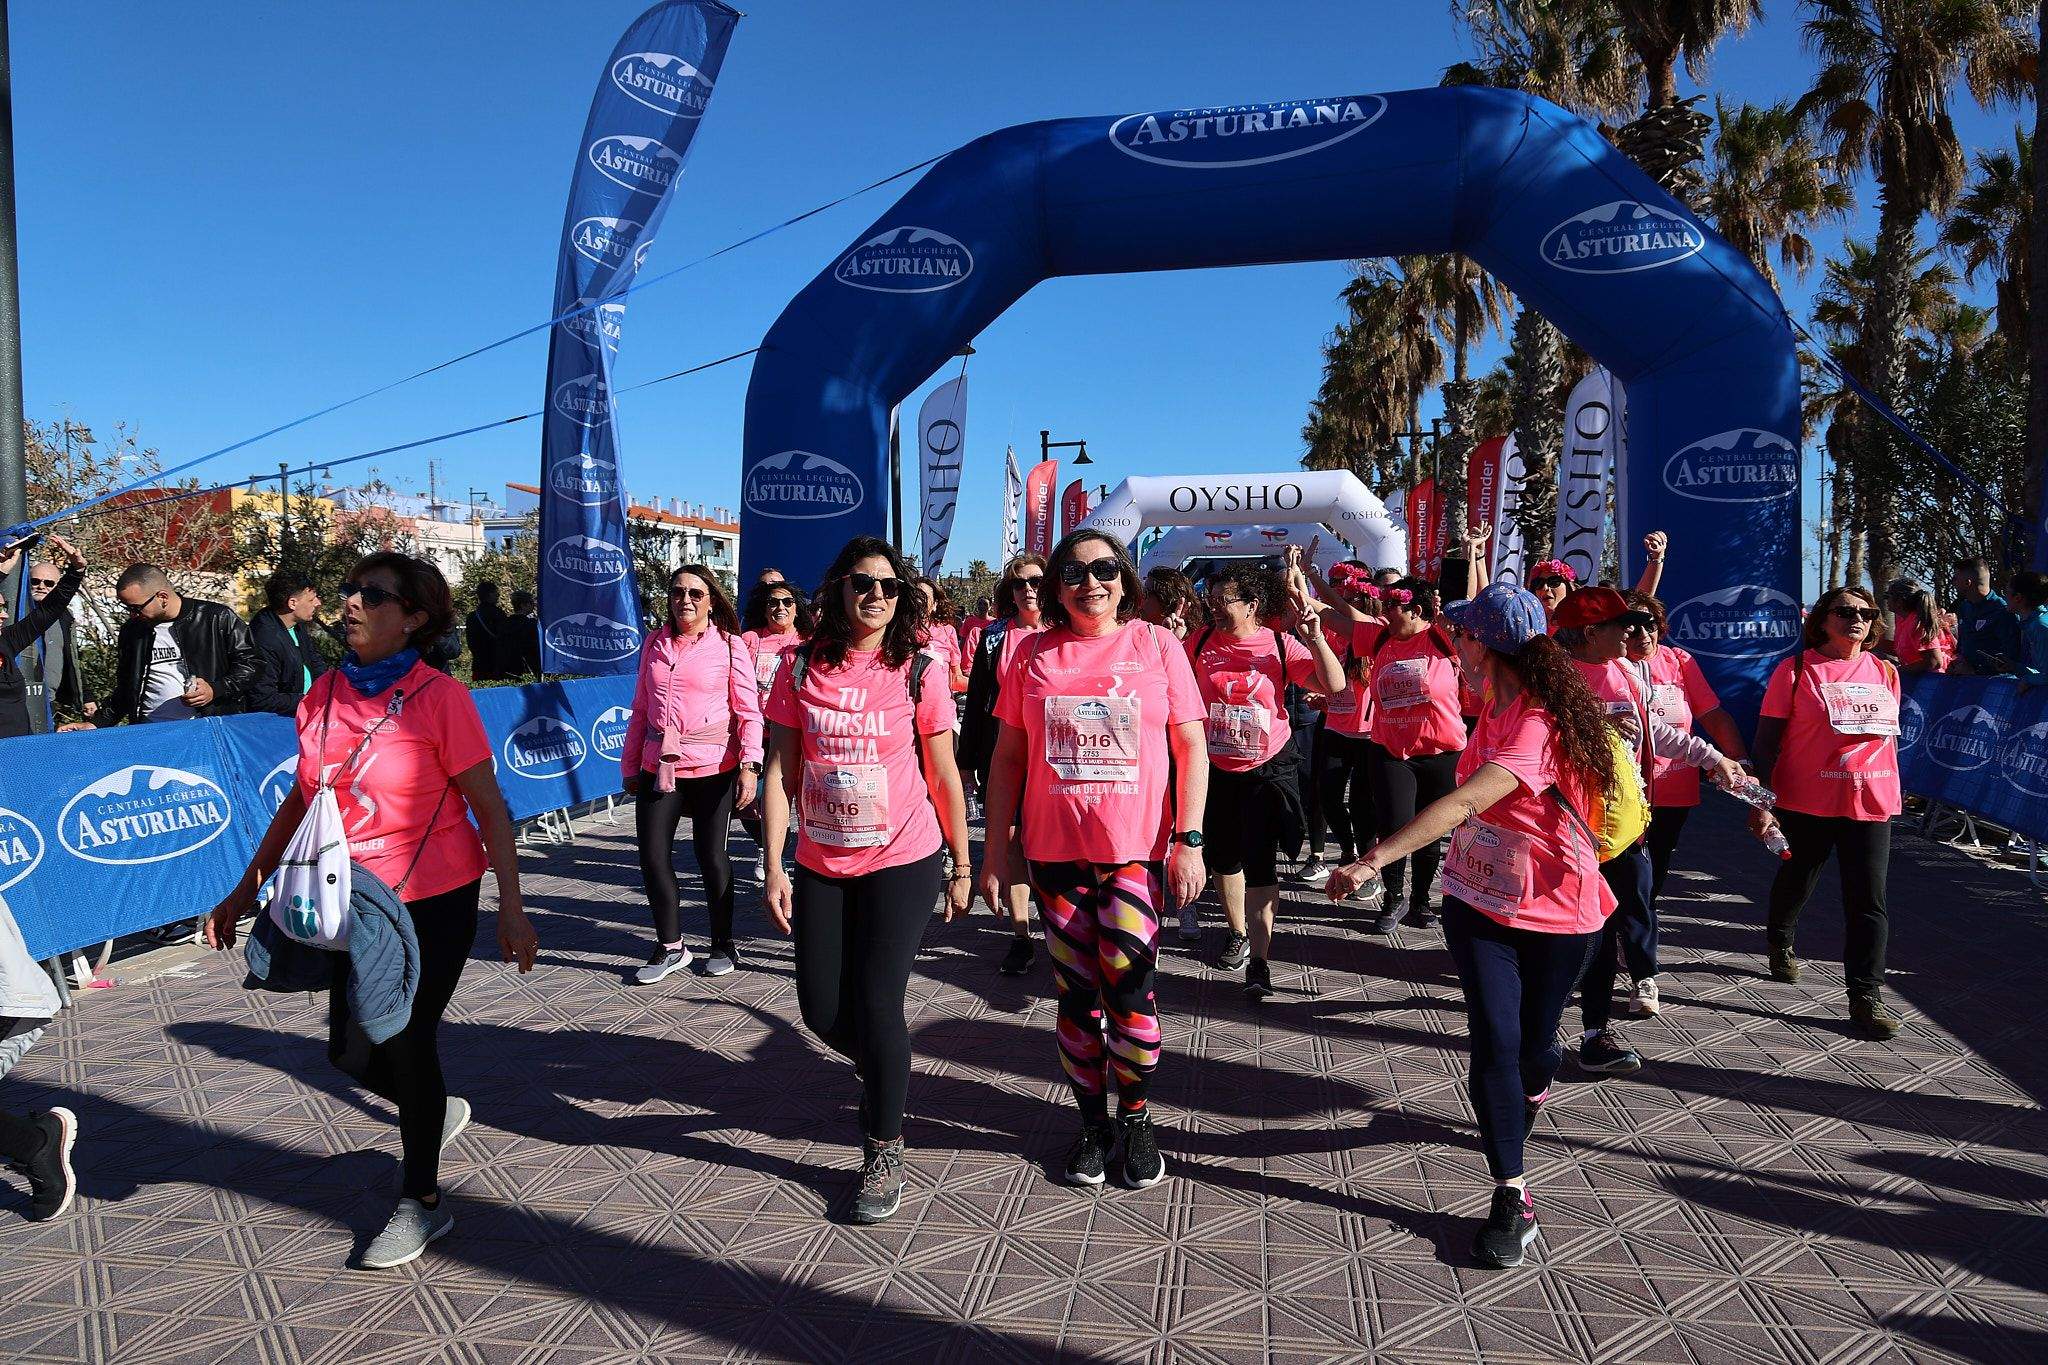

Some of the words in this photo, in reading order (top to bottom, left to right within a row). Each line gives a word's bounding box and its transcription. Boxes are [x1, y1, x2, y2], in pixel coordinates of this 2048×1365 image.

[1174, 105, 1258, 117] CENTRAL
[1128, 101, 1367, 146] ASTURIANA
[596, 144, 670, 187] ASTURIA
[1579, 224, 1634, 237] CENTRAL
[864, 248, 910, 258] CENTRAL
[911, 247, 958, 255] LECHERA
[1553, 231, 1698, 261] ASTURIANA
[842, 255, 962, 278] ASTURIANA
[1699, 453, 1753, 463] CENTRAL
[806, 475, 852, 485] LECHERA
[1674, 458, 1797, 487] ASTURIANA
[747, 476, 855, 505] ASTURIANA
[1169, 483, 1303, 513] OYSHO
[1477, 460, 1494, 521] ntander
[1562, 401, 1611, 586] OYSHO
[1034, 480, 1049, 552] Santander
[1092, 517, 1131, 527] OYSHO
[1342, 511, 1383, 520] OYSHO
[1416, 498, 1427, 558] Santander
[1700, 610, 1754, 618] CENTRAL
[1674, 613, 1798, 640] ASTURIANA
[553, 627, 636, 651] ASTURIANA
[838, 687, 868, 711] TU
[1852, 703, 1879, 713] 016
[807, 707, 891, 737] DORSAL
[816, 737, 880, 764] SUMA
[1076, 733, 1111, 748] 016
[513, 740, 583, 768] ASTURIANA
[1820, 770, 1852, 779] CARRERA
[1853, 771, 1862, 779] DE
[1048, 784, 1081, 795] CARRERA
[1083, 784, 1094, 794] DE
[1097, 783, 1107, 794] LA
[1109, 783, 1139, 795] MUJER
[98, 799, 156, 815] CENTRAL
[159, 788, 211, 805] LECHERA
[827, 801, 859, 816] 016
[78, 801, 223, 850] ASTURIANA
[351, 838, 385, 853] MUJER
[1467, 855, 1494, 878] 016
[1444, 879, 1468, 896] OYSHO
